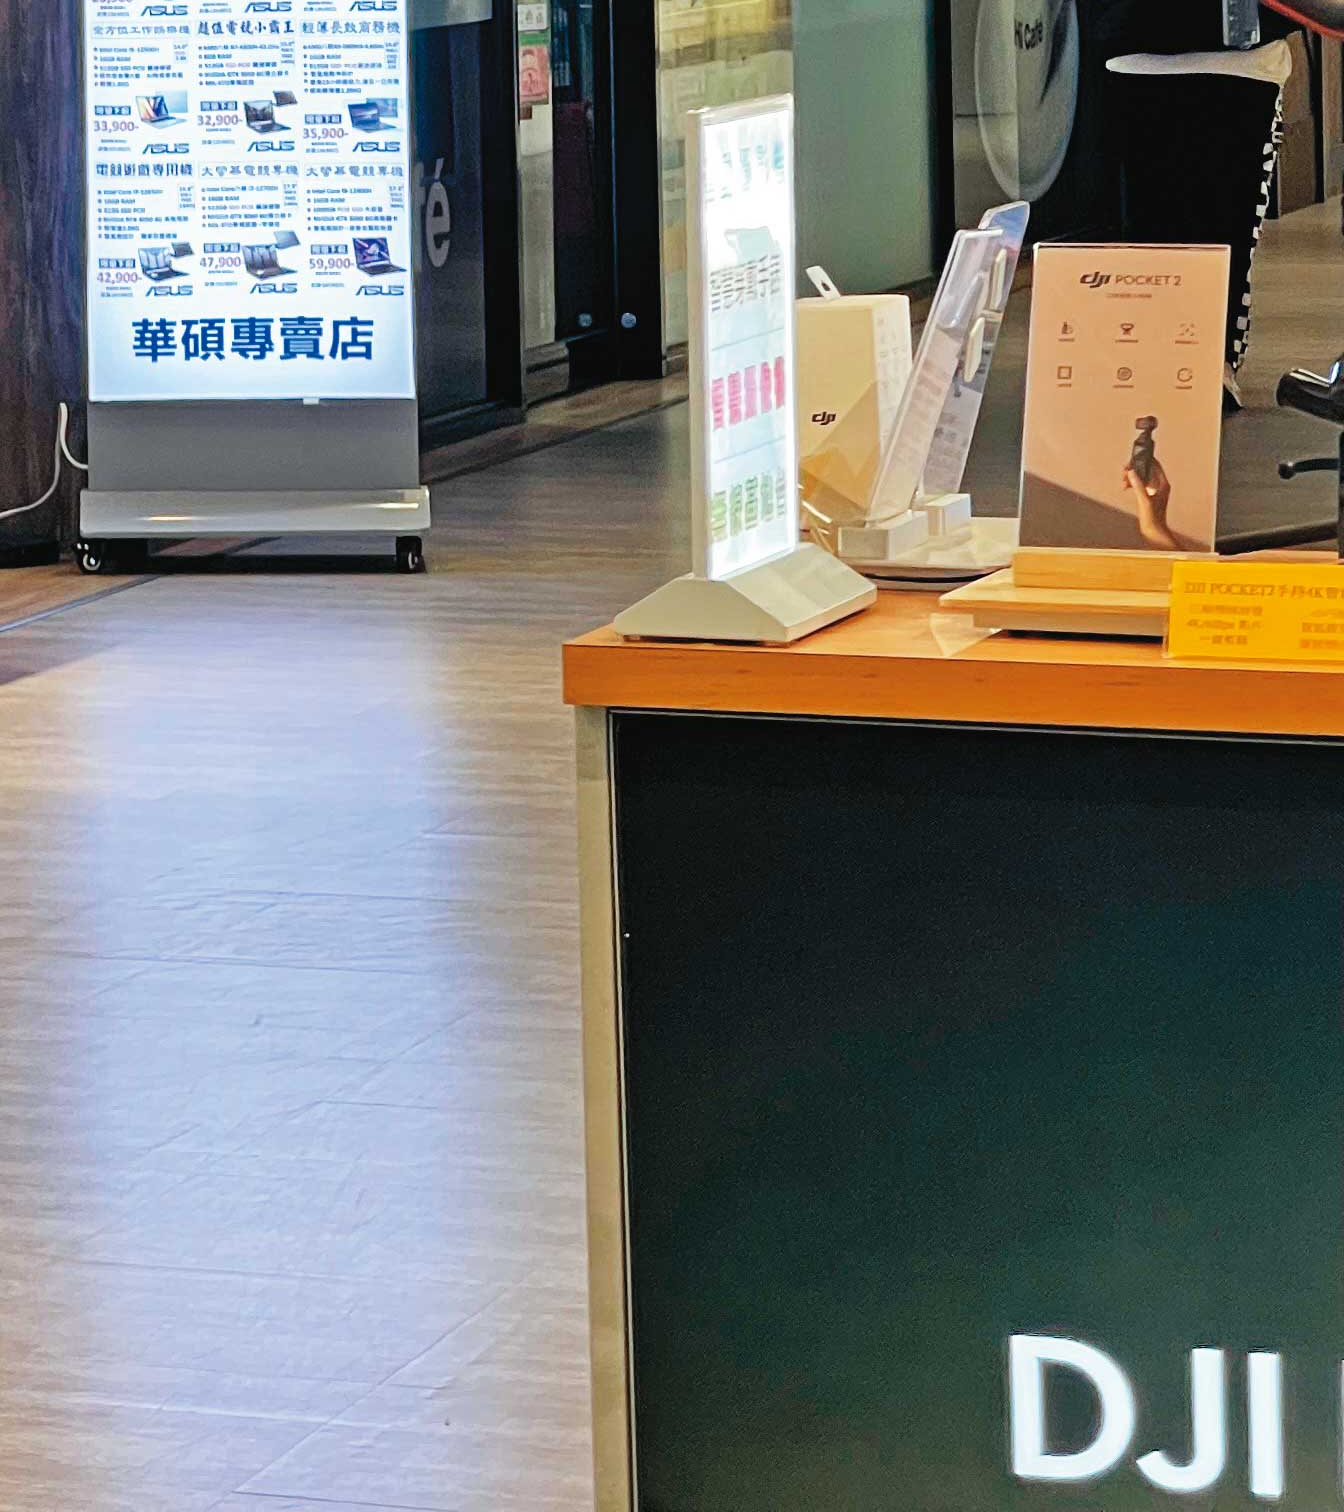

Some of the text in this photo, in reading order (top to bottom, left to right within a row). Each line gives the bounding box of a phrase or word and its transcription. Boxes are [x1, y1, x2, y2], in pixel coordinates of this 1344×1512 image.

[140, 4, 189, 17] ASUS
[244, 1, 293, 13] ASUS
[349, 0, 398, 13] ASUS
[142, 143, 190, 155] ASUS
[247, 140, 295, 153] ASUS
[352, 140, 401, 153] ASUS
[1115, 275, 1170, 286] POCKET
[1173, 274, 1182, 287] 2
[145, 285, 194, 297] ASUS
[249, 282, 298, 294] ASUS
[355, 284, 405, 296] ASUS
[131, 316, 375, 363] 華碩專賣店
[1008, 1334, 1283, 1499] DJI
